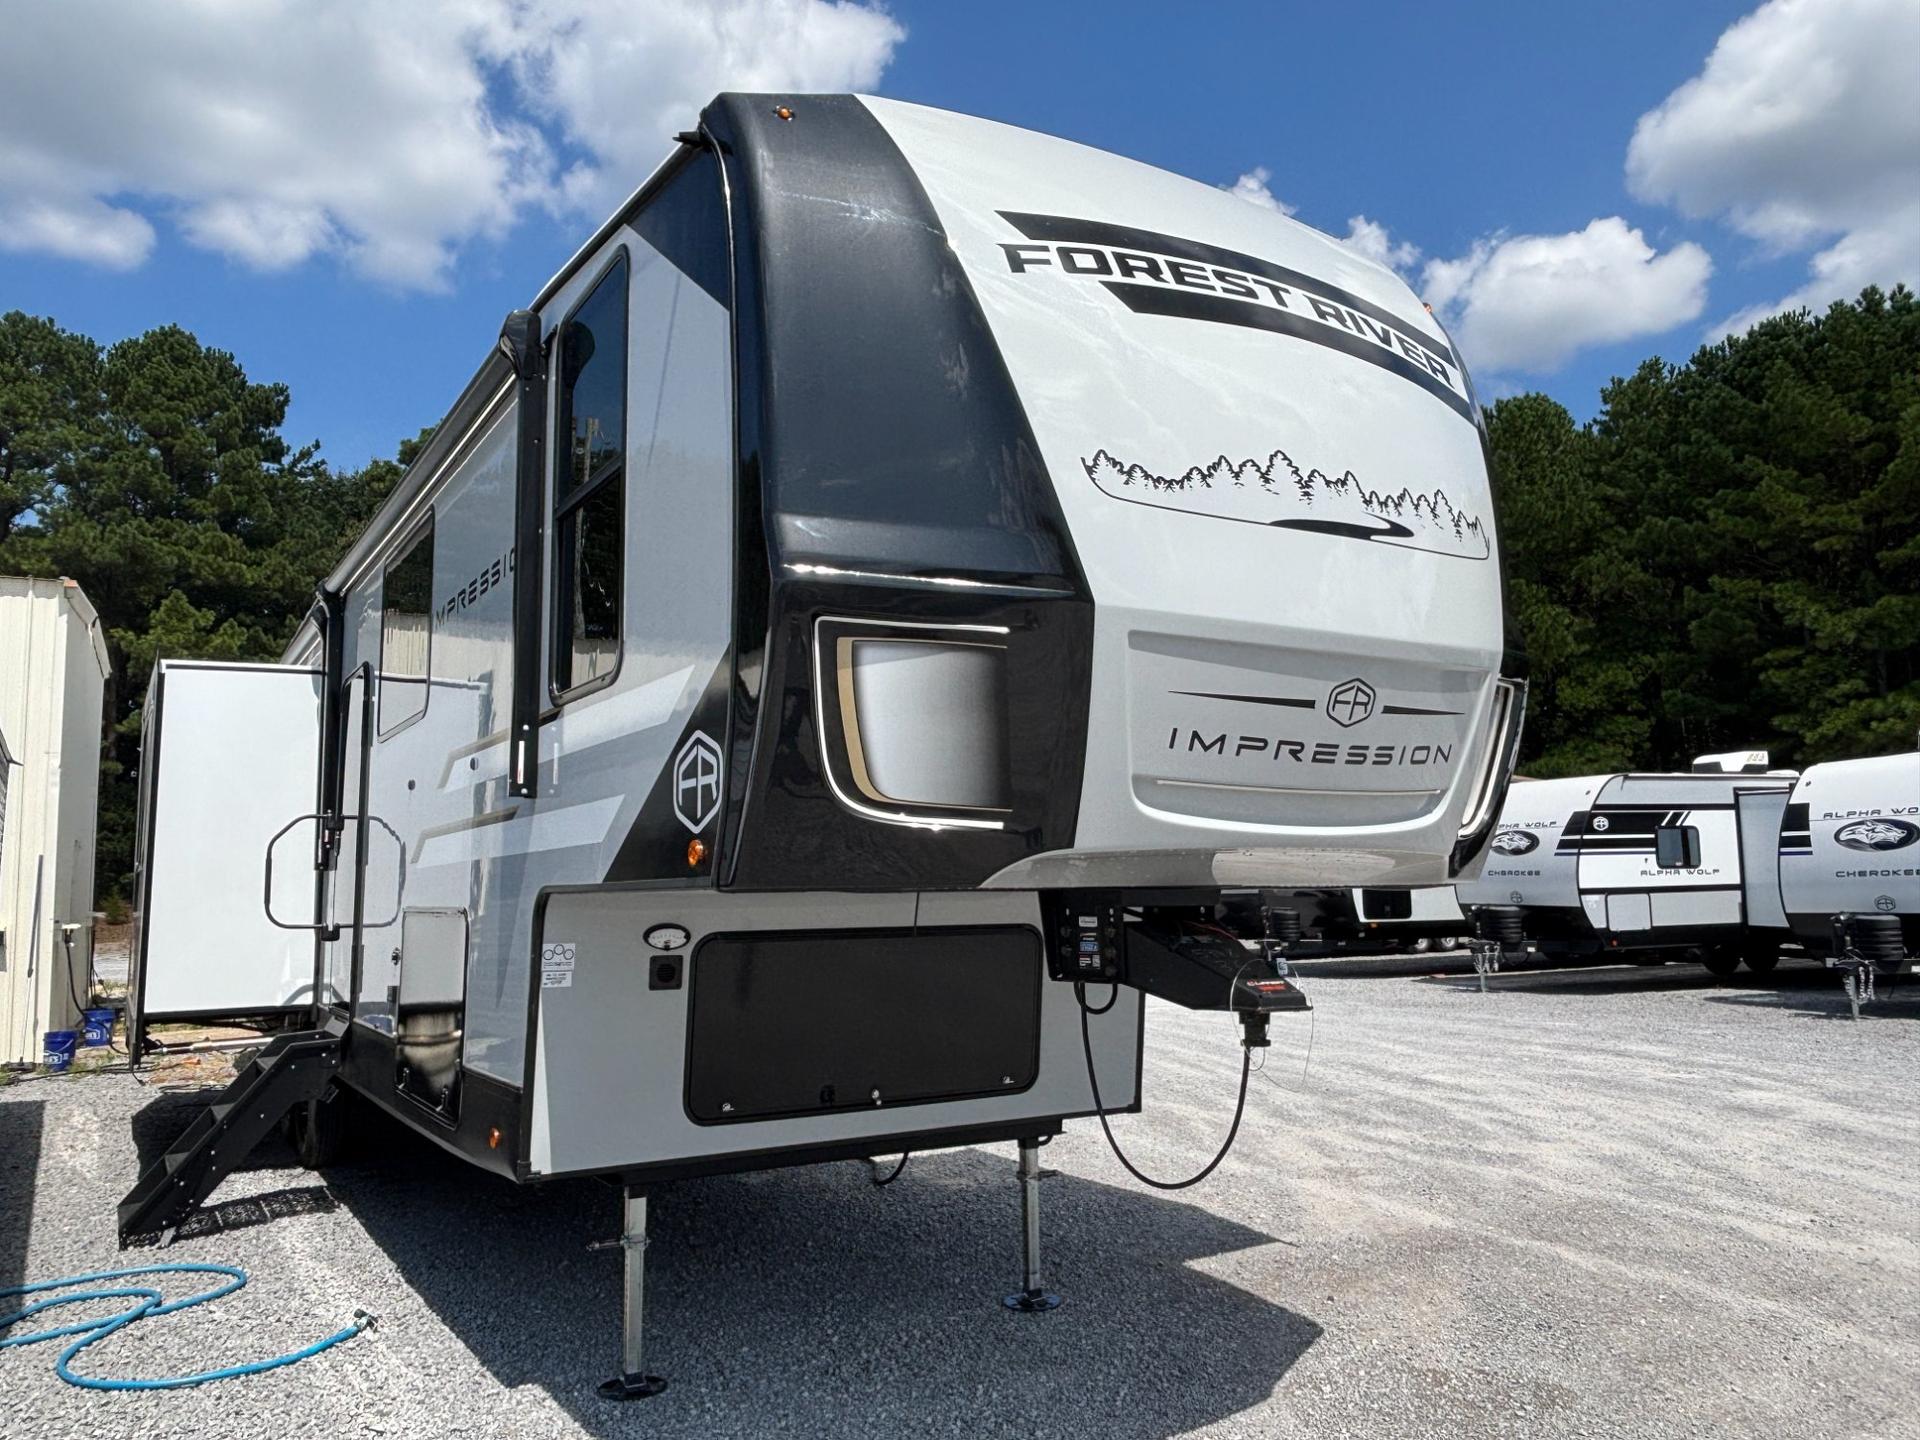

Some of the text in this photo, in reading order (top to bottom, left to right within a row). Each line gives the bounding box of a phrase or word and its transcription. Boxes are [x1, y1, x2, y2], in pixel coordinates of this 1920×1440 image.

[995, 242, 1456, 389] FOREST RIVER
[1168, 726, 1454, 766] IMPRESSION
[1823, 809, 1882, 819] ALPHA
[1524, 820, 1557, 828] WOLF
[1640, 868, 1720, 877] ALPHA WOLF
